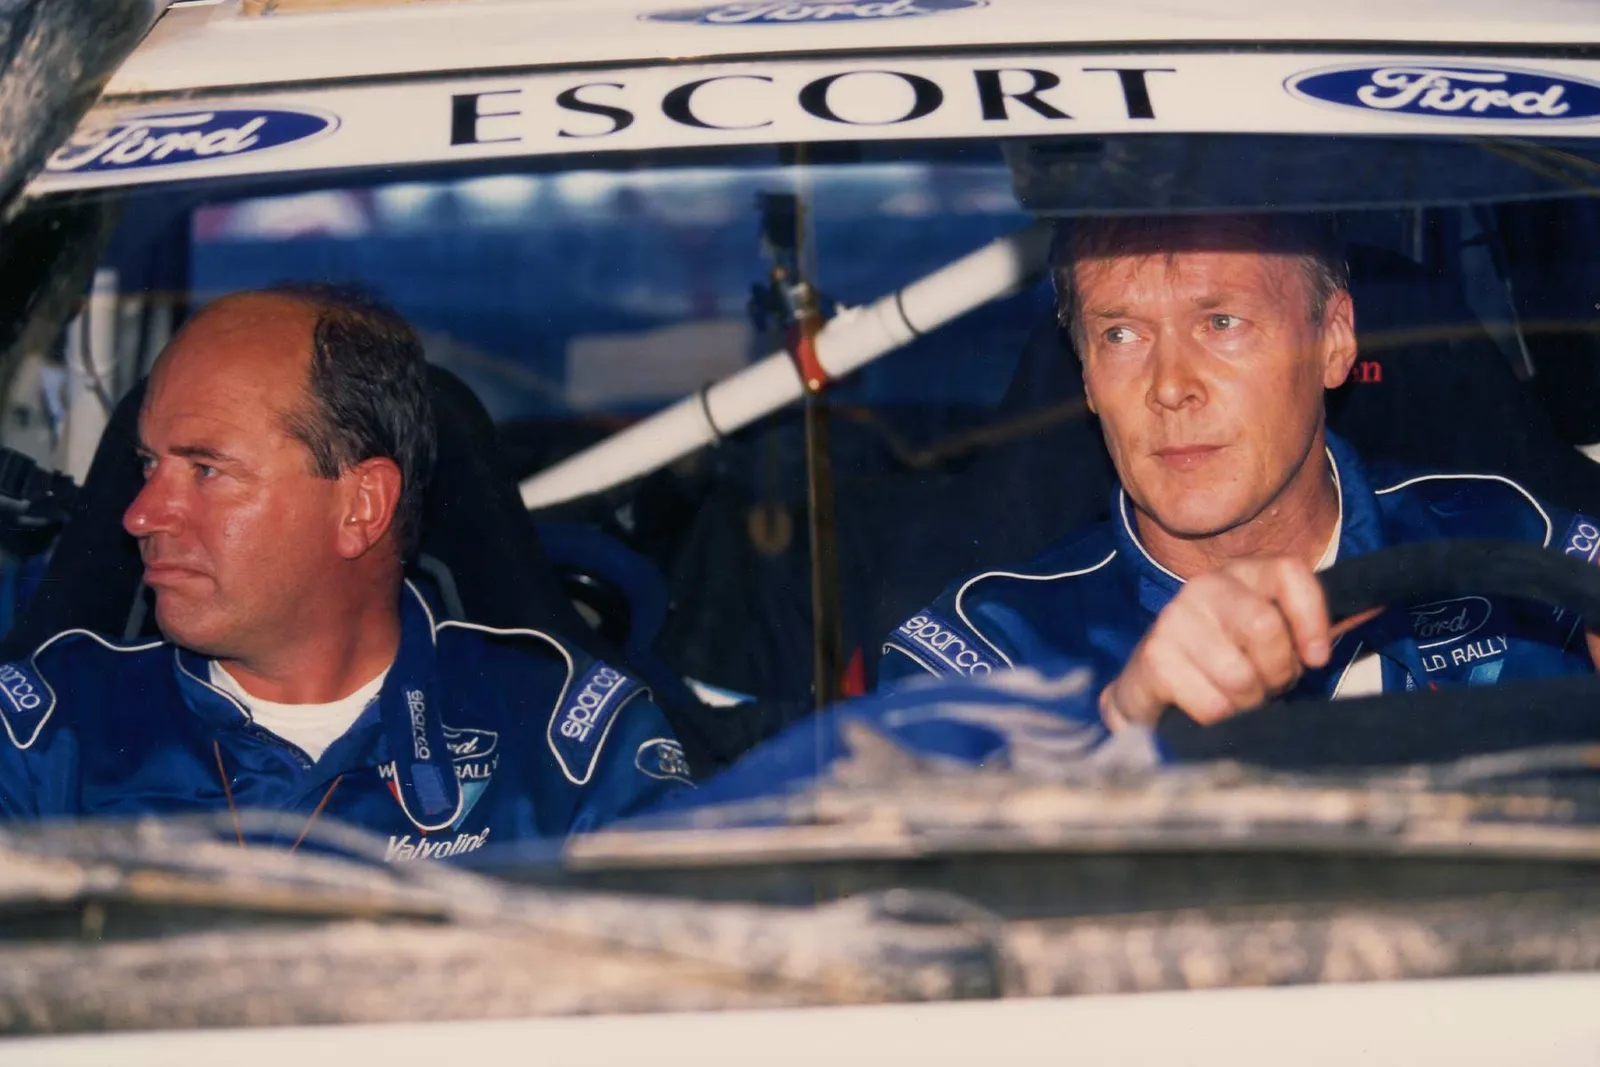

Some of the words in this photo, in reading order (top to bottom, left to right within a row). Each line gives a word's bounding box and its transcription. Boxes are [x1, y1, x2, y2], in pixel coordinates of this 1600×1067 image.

[451, 67, 1177, 146] ESCORT
[1357, 67, 1570, 116] Ford
[46, 112, 267, 171] Ford
[900, 615, 992, 677] sparco
[1451, 634, 1508, 666] RALLY
[407, 690, 430, 760] sparco
[560, 666, 627, 743] sparco
